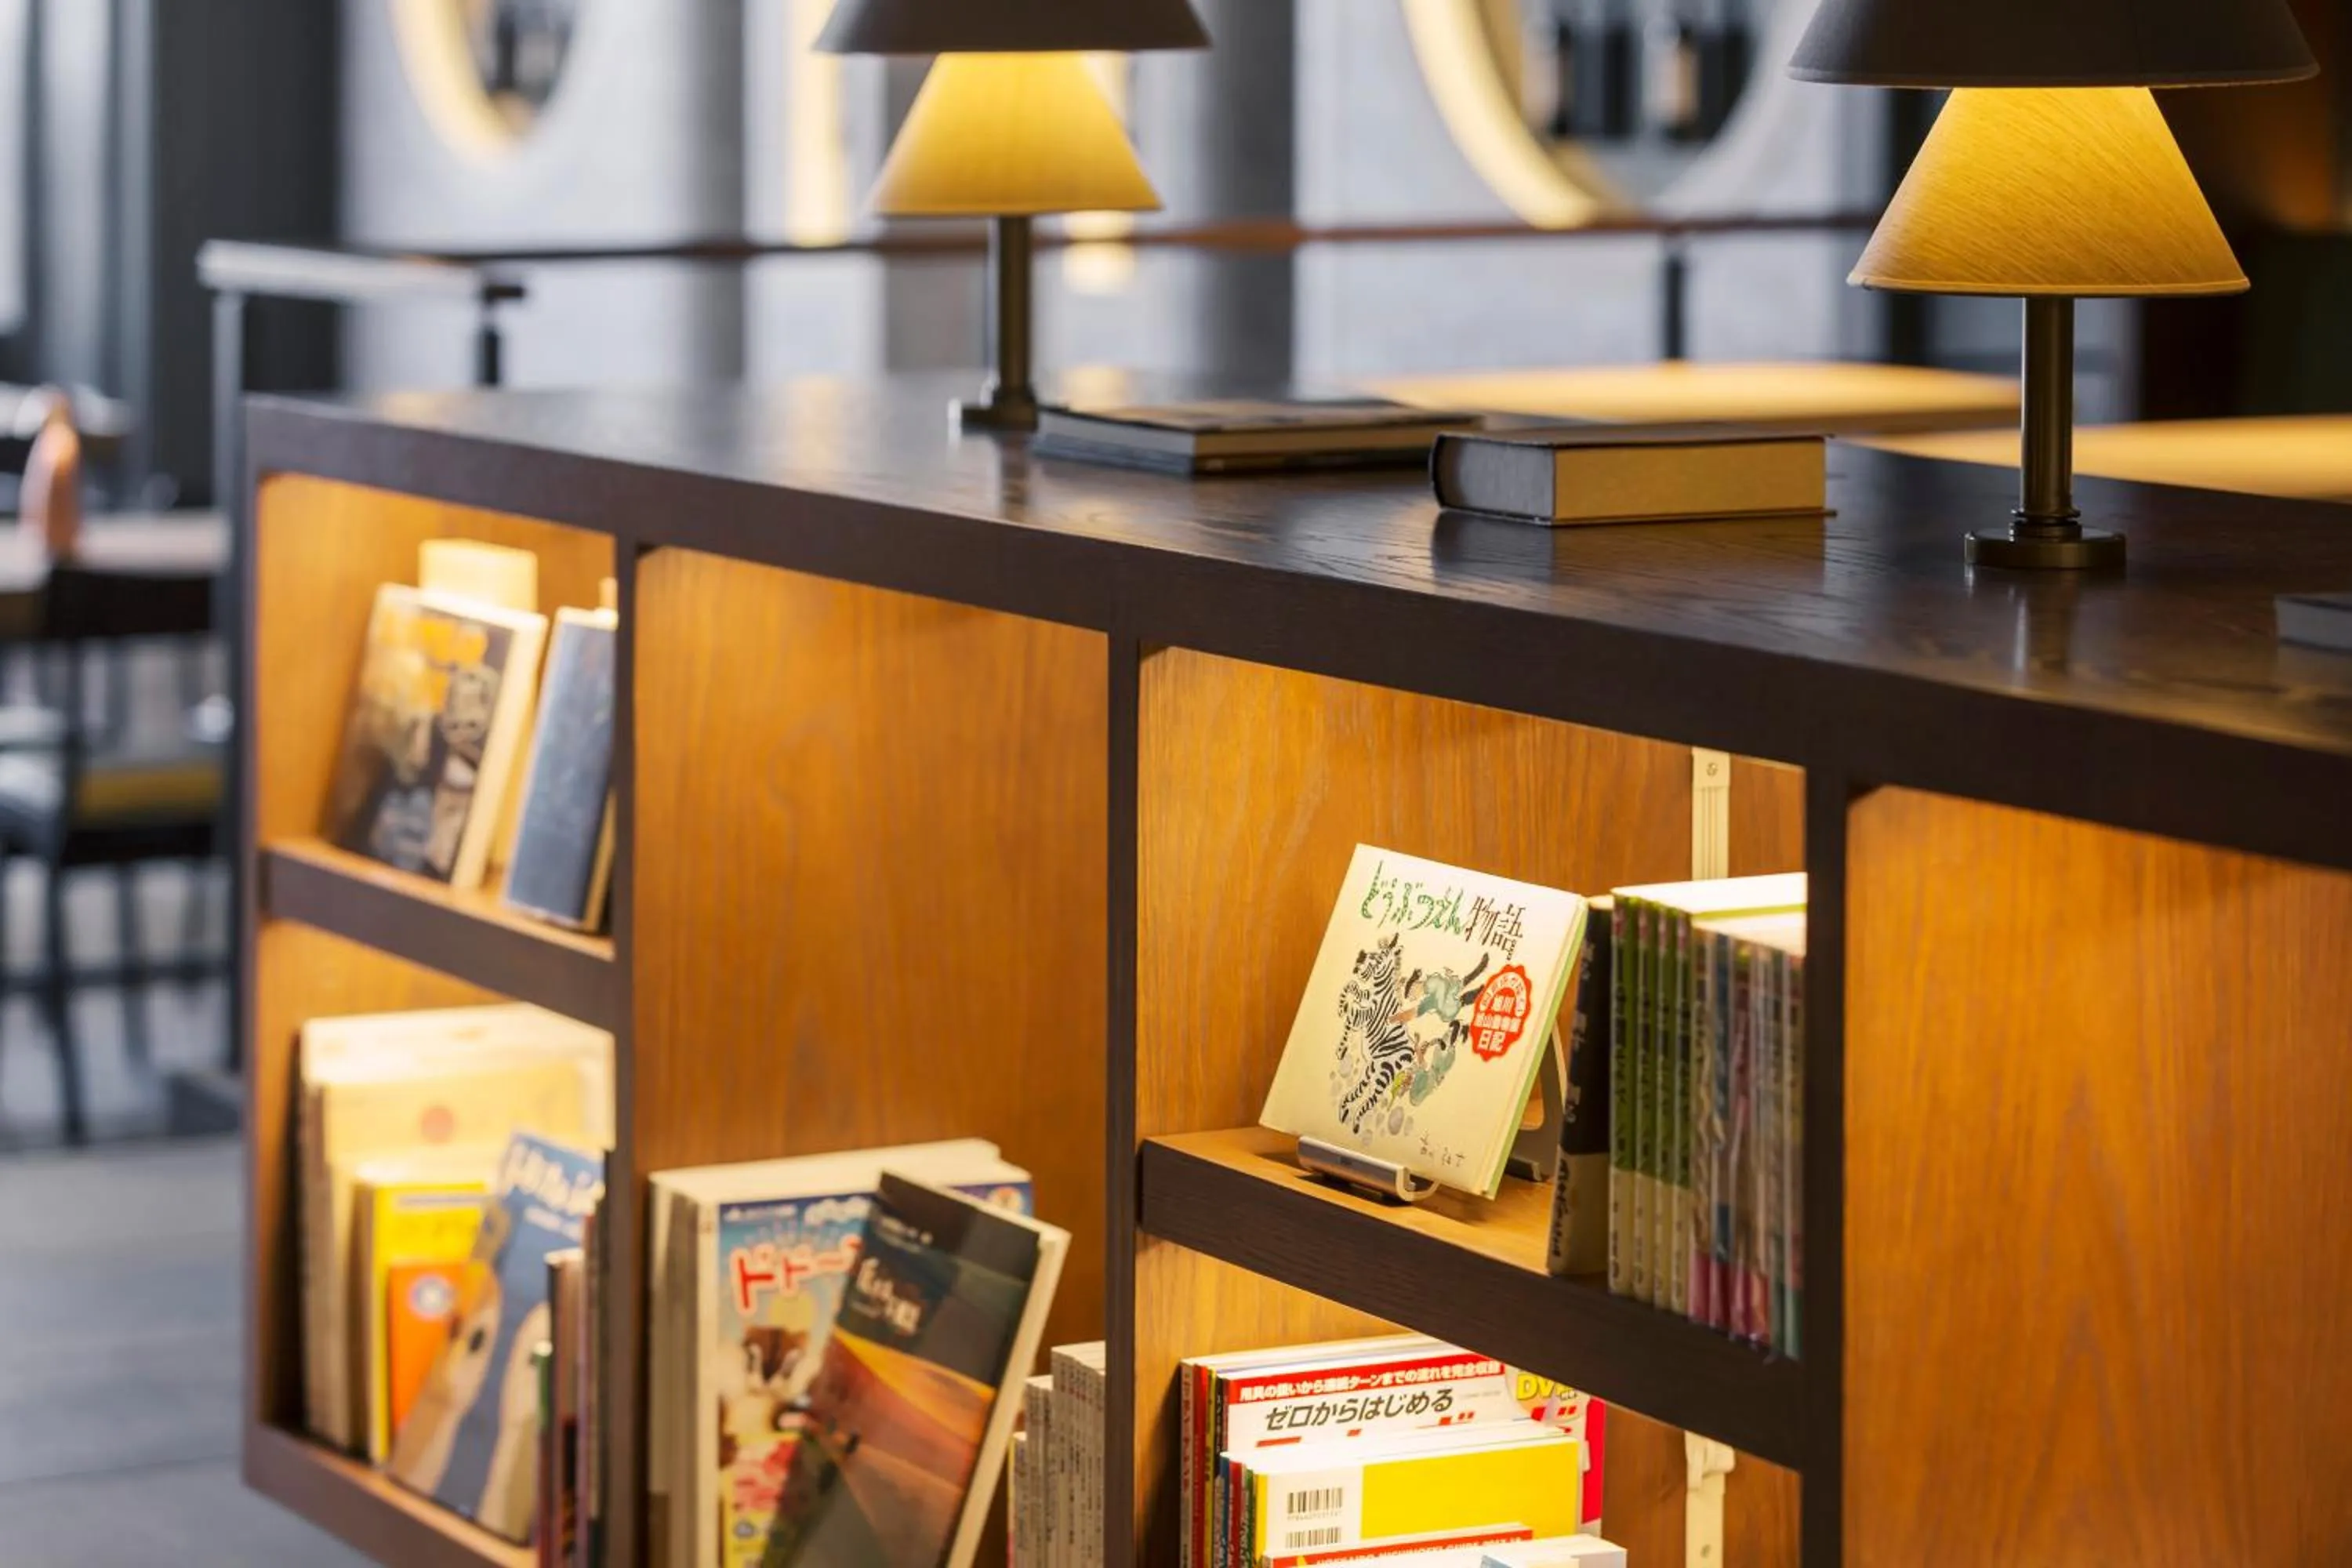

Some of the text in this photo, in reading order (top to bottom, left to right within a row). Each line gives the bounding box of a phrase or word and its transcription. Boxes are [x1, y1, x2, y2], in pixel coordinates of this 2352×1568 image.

[1359, 860, 1527, 960] どうぶつえん物語
[1477, 1029, 1506, 1052] 日記
[1265, 1388, 1454, 1431] ゼロからはじめる
